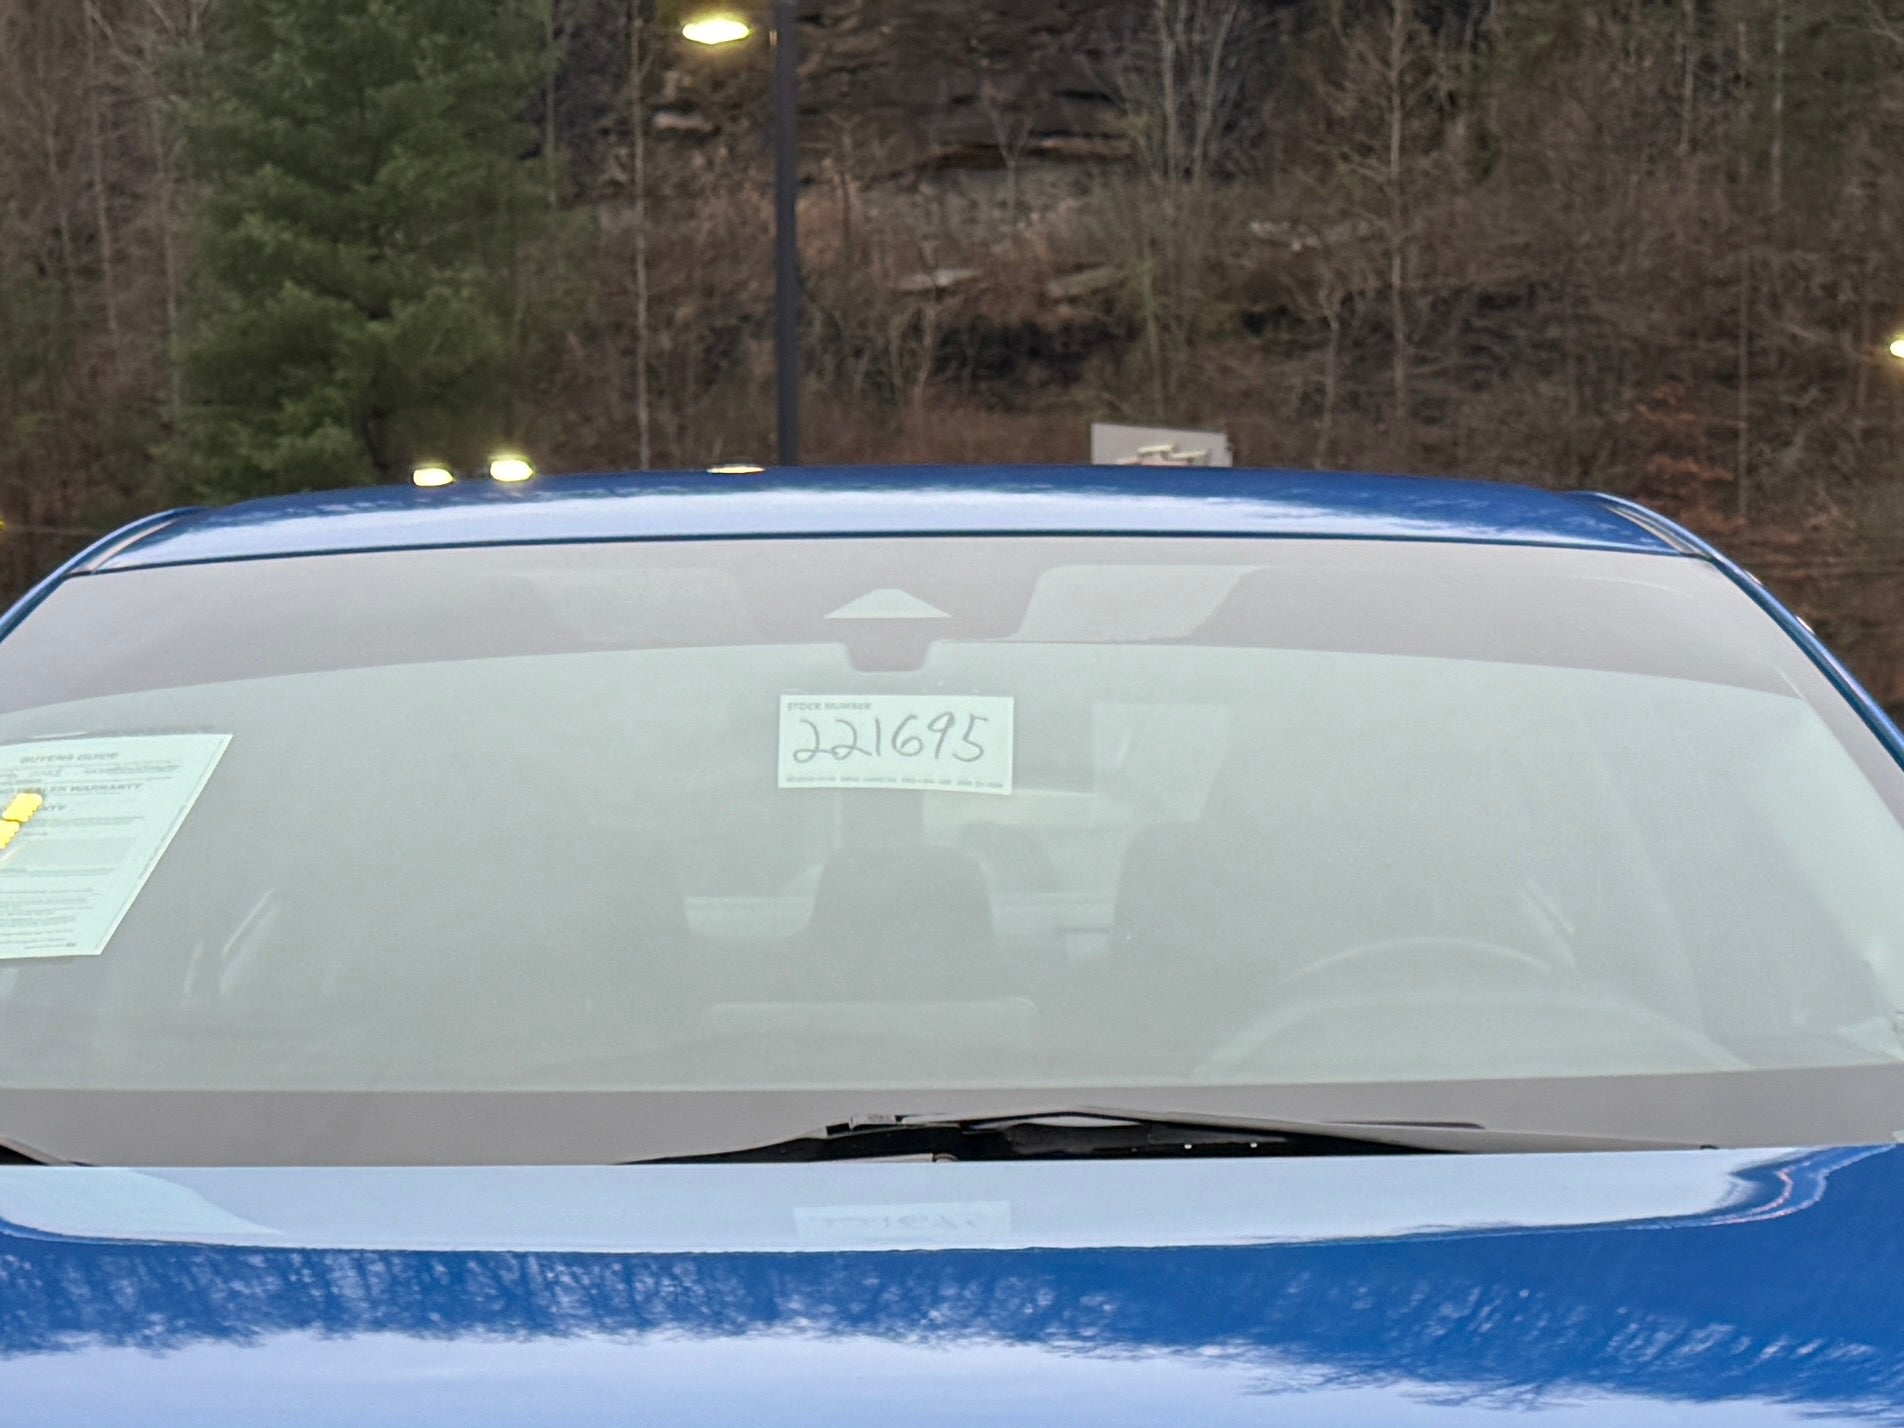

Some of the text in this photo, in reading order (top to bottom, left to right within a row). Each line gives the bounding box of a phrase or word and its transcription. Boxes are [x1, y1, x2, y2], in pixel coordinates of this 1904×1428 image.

[787, 702, 871, 711] STOCK NUMBER
[793, 711, 990, 764] 221695
[77, 752, 120, 761] GUIDE
[70, 782, 143, 792] WARRANTY
